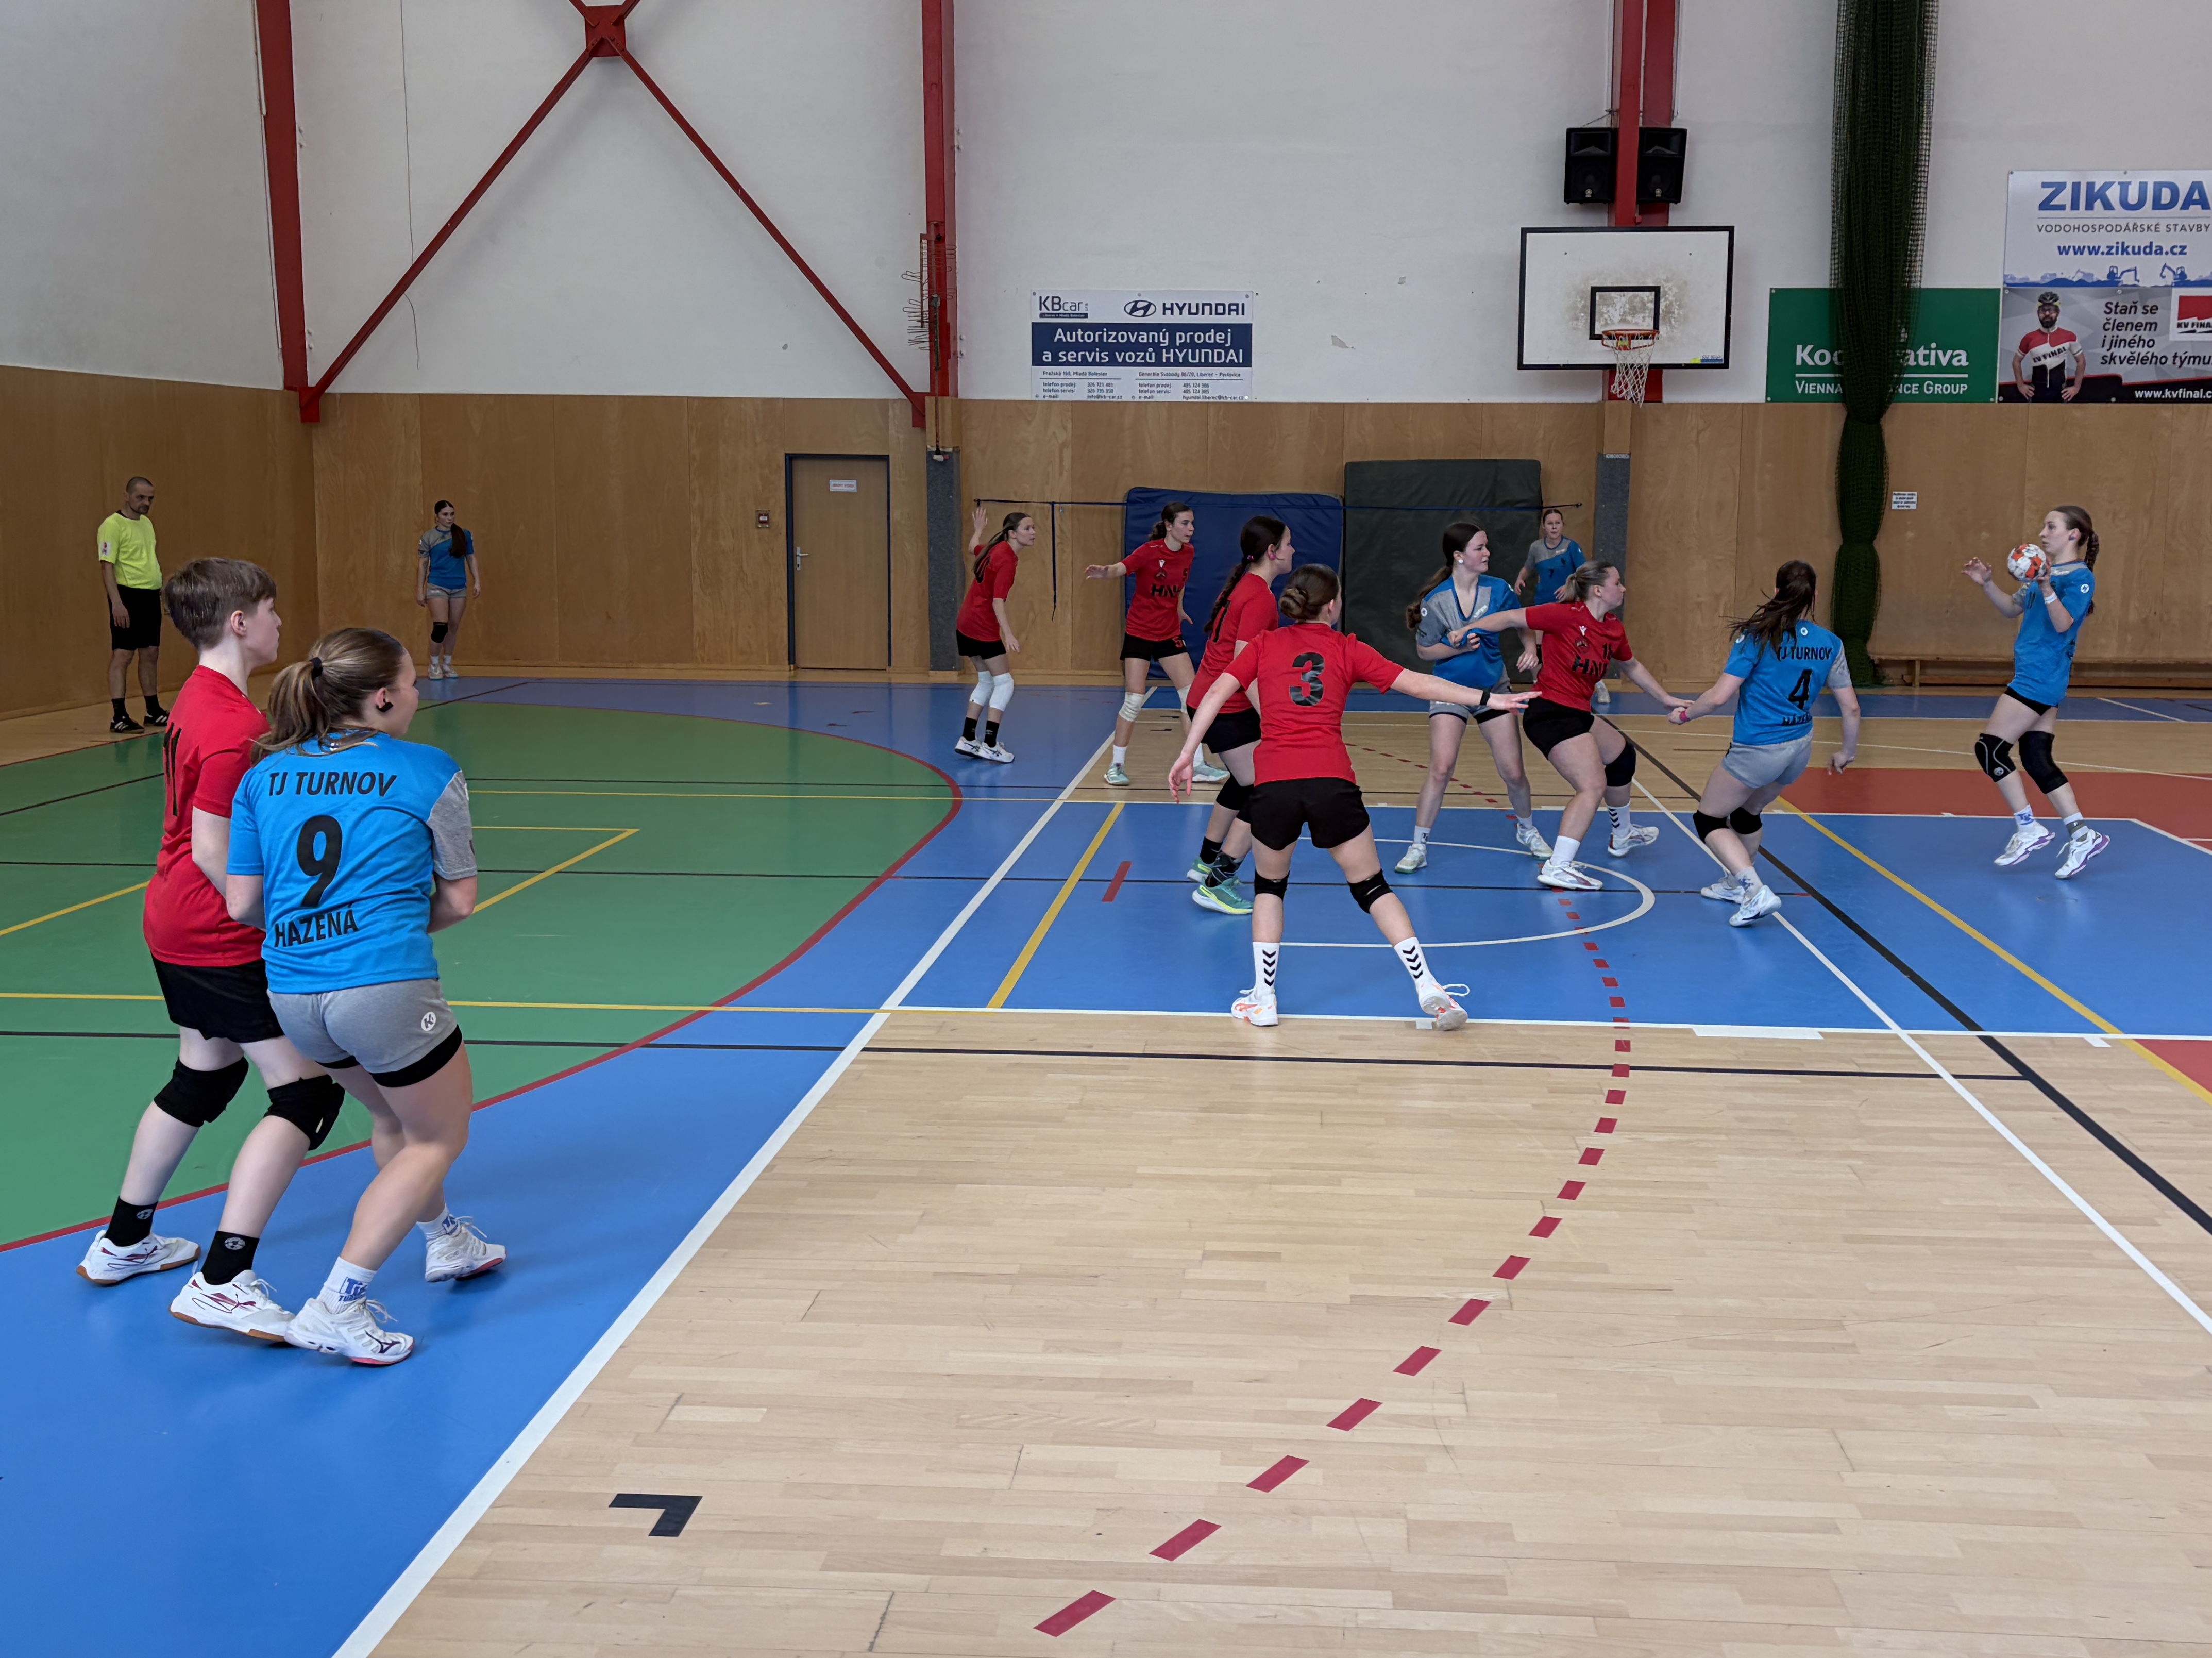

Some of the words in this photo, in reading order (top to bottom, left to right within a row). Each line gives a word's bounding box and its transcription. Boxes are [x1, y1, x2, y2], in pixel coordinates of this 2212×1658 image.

[2038, 181, 2211, 211] ZIKUDA
[2037, 222, 2160, 233] VODOHOSPODÁŘSKÉ
[2166, 223, 2210, 232] STAVBY
[2057, 242, 2187, 256] www.zikuda.cz
[1162, 303, 1245, 316] HYUNDAI
[2104, 300, 2138, 315] Staň
[2141, 304, 2159, 315] se
[2103, 317, 2158, 331] členem
[1054, 328, 1169, 346] Autorizovaný
[1176, 329, 1232, 346] prodej
[2101, 335, 2107, 348] i
[2107, 334, 2155, 351] jiného
[1042, 350, 1052, 362] a
[1058, 348, 1109, 362] servis
[1115, 348, 1155, 363] vozů
[1162, 349, 1243, 363] HYUNDAI
[2101, 351, 2168, 365] skvělého
[1791, 647, 1833, 660] TURNOV
[1289, 651, 1325, 706] 3
[1788, 669, 1813, 710] 4
[269, 771, 288, 796] TJ
[295, 771, 397, 797] TURNOV
[296, 814, 343, 908] 9
